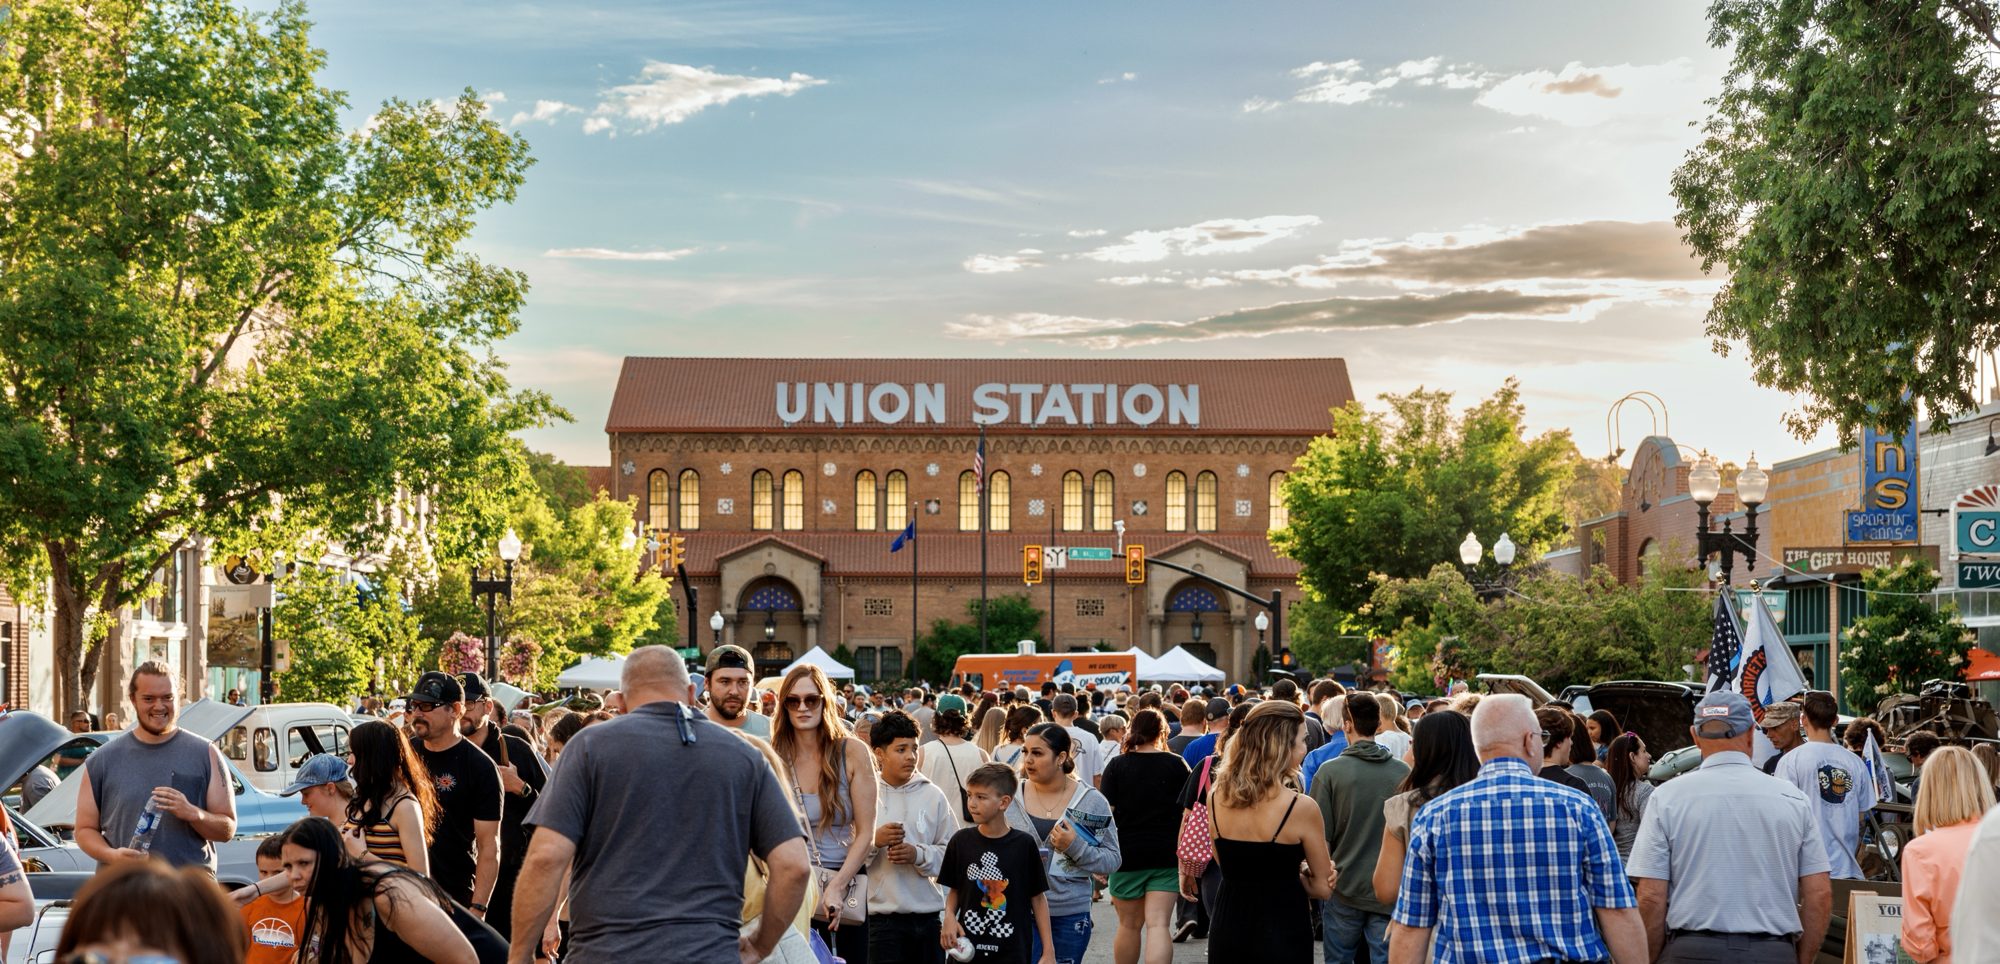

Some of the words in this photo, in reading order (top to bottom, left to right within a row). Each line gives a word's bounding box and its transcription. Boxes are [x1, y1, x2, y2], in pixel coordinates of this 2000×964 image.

[777, 382, 945, 423] UNION
[973, 383, 1199, 425] STATION
[1785, 550, 1809, 563] THE
[1847, 551, 1891, 569] HOUSE
[1095, 675, 1121, 686] SKOOL
